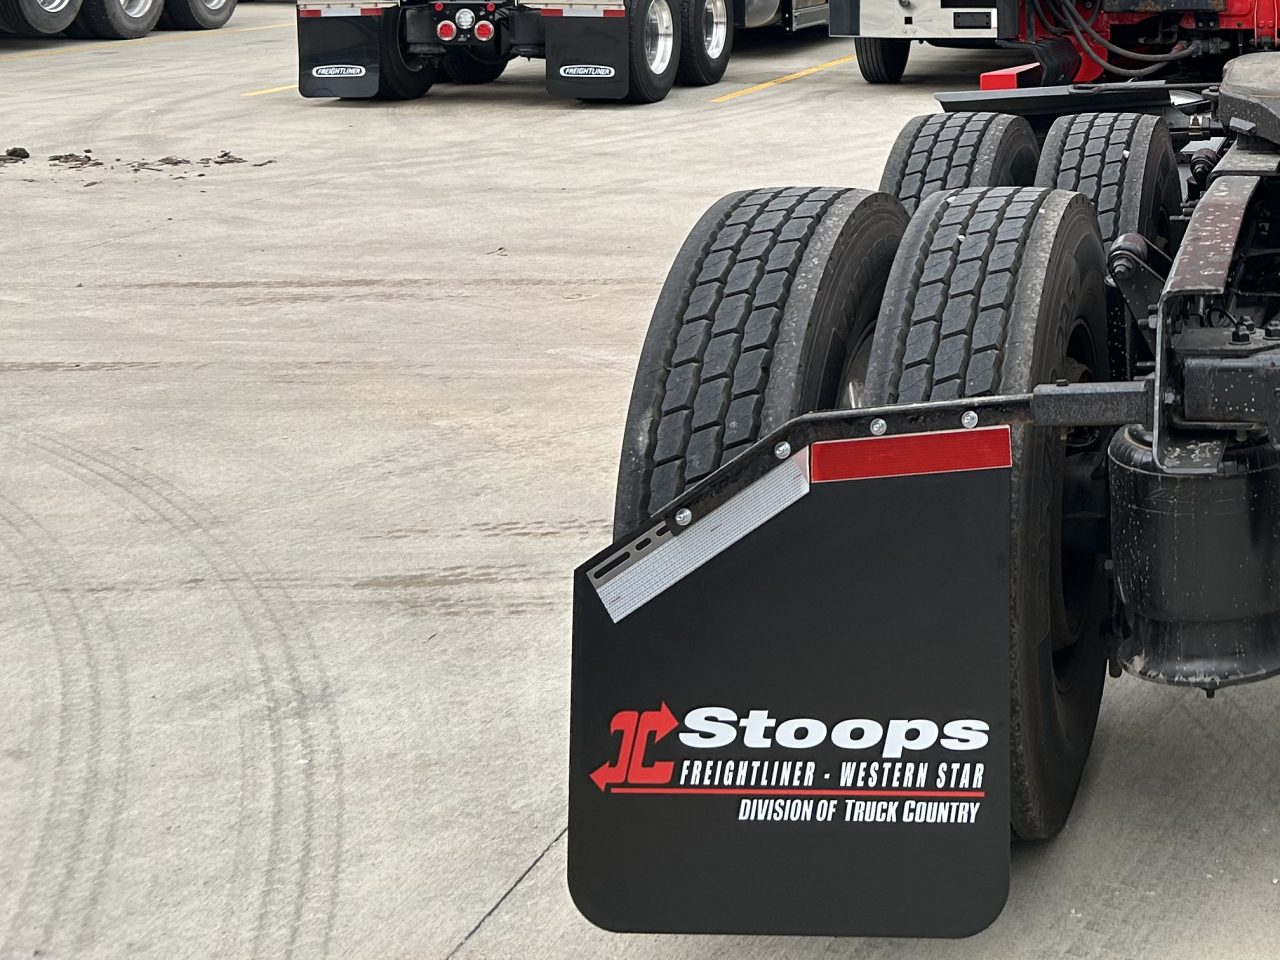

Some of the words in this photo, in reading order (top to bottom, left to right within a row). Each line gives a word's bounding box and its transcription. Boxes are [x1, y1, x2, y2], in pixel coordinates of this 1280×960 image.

[679, 707, 990, 759] Stoops
[679, 760, 816, 787] FREIGHTLINER
[840, 762, 929, 788] WESTERN
[936, 763, 985, 789] STAR
[738, 798, 814, 821] DIVISION
[815, 799, 838, 822] OF
[845, 800, 900, 823] TRUCK
[902, 800, 981, 824] COUNTRY
